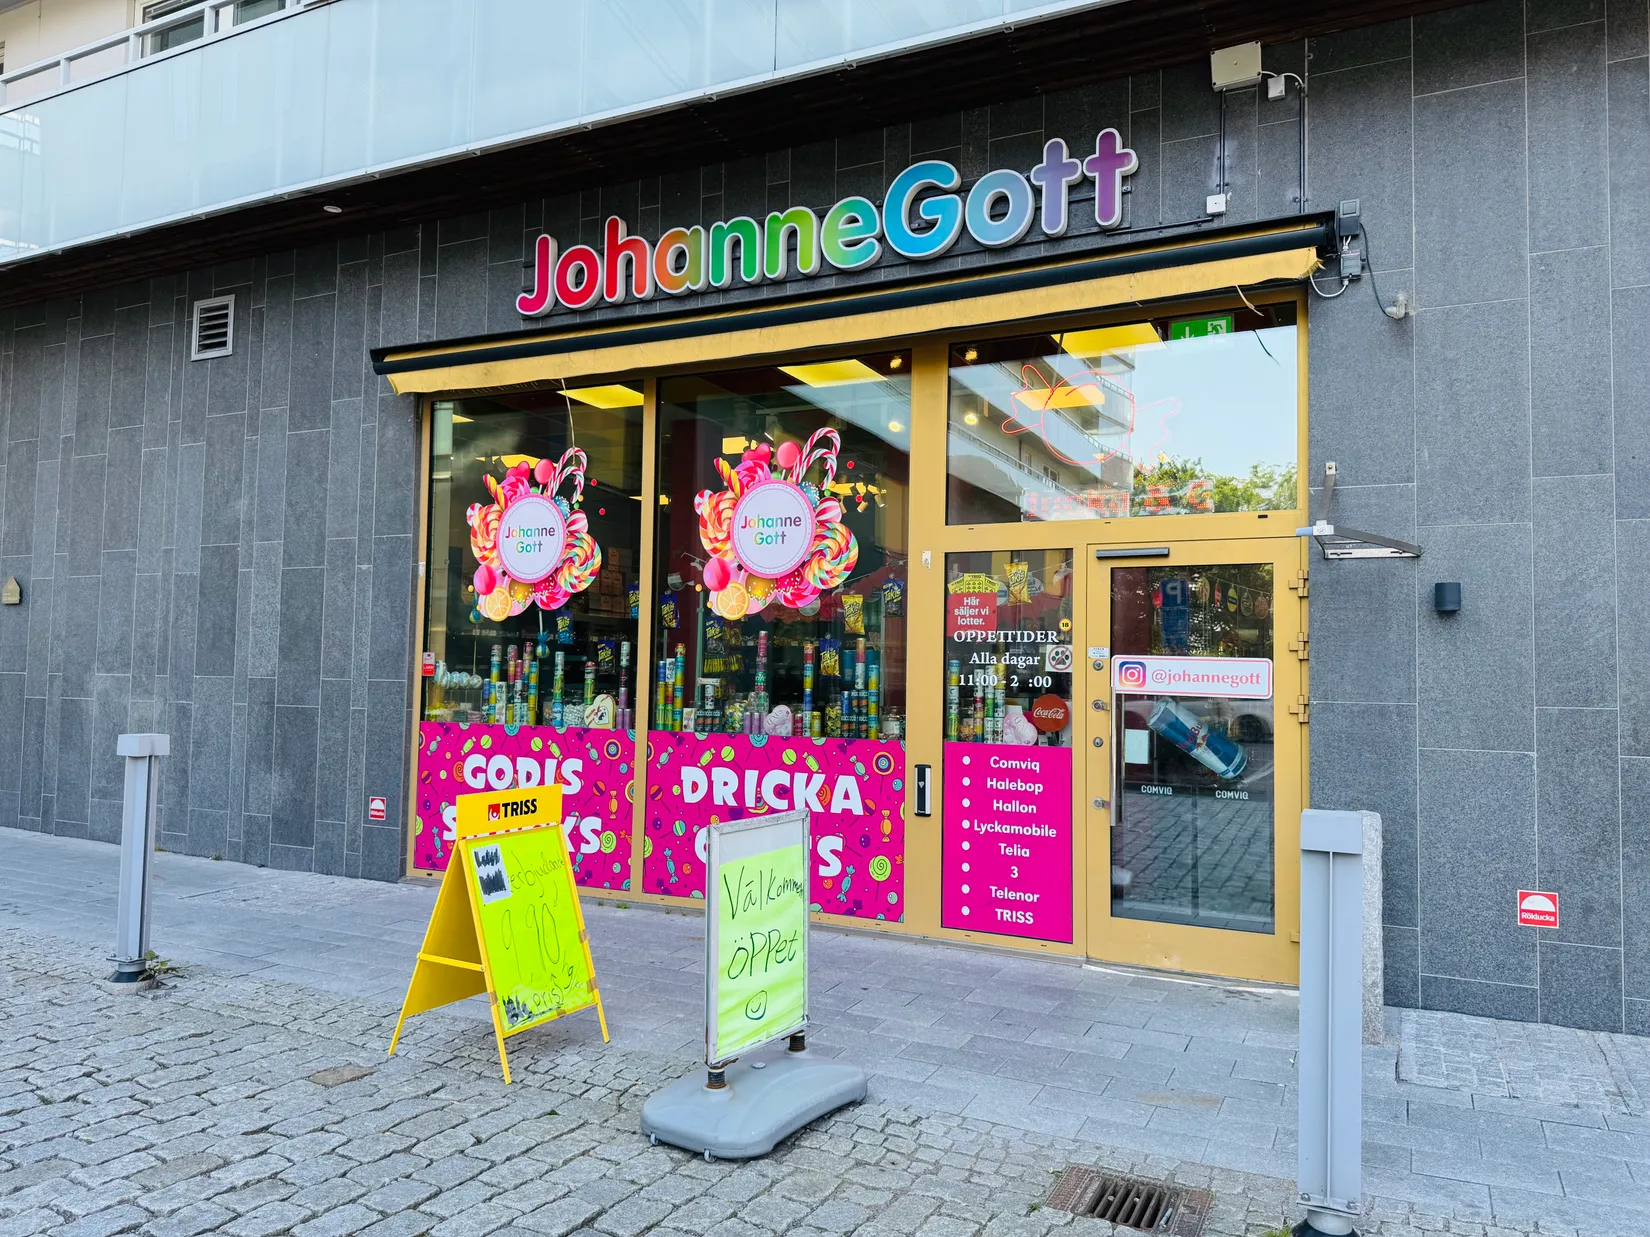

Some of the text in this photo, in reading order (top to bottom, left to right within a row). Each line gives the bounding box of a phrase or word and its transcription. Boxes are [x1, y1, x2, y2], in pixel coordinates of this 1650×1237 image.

[741, 514, 802, 529] Johanne
[505, 525, 556, 539] Johanne
[754, 531, 786, 546] Gott
[516, 541, 543, 553] Gott
[963, 597, 979, 605] Här
[954, 606, 989, 617] säljer vi
[957, 617, 985, 625] lotter.
[969, 652, 1040, 668] Alla dagar
[959, 675, 997, 687] 11:00
[1151, 668, 1261, 687] @johannegott
[990, 756, 1040, 773] Comviq
[463, 754, 583, 795] GODIS
[681, 766, 864, 816] DRICKA
[986, 777, 1044, 795] Halebop
[1141, 784, 1173, 796] COMVIQ
[1215, 790, 1249, 800] COMVIQ
[502, 799, 537, 818] TRISS
[993, 799, 1037, 813] Hallon
[974, 819, 1057, 838] Lyckamobile
[998, 843, 1030, 857] Telia
[1010, 866, 1019, 878] 3
[989, 886, 1040, 903] Telenor
[995, 908, 1034, 924] TRISS
[1521, 912, 1555, 922] Röklucka
